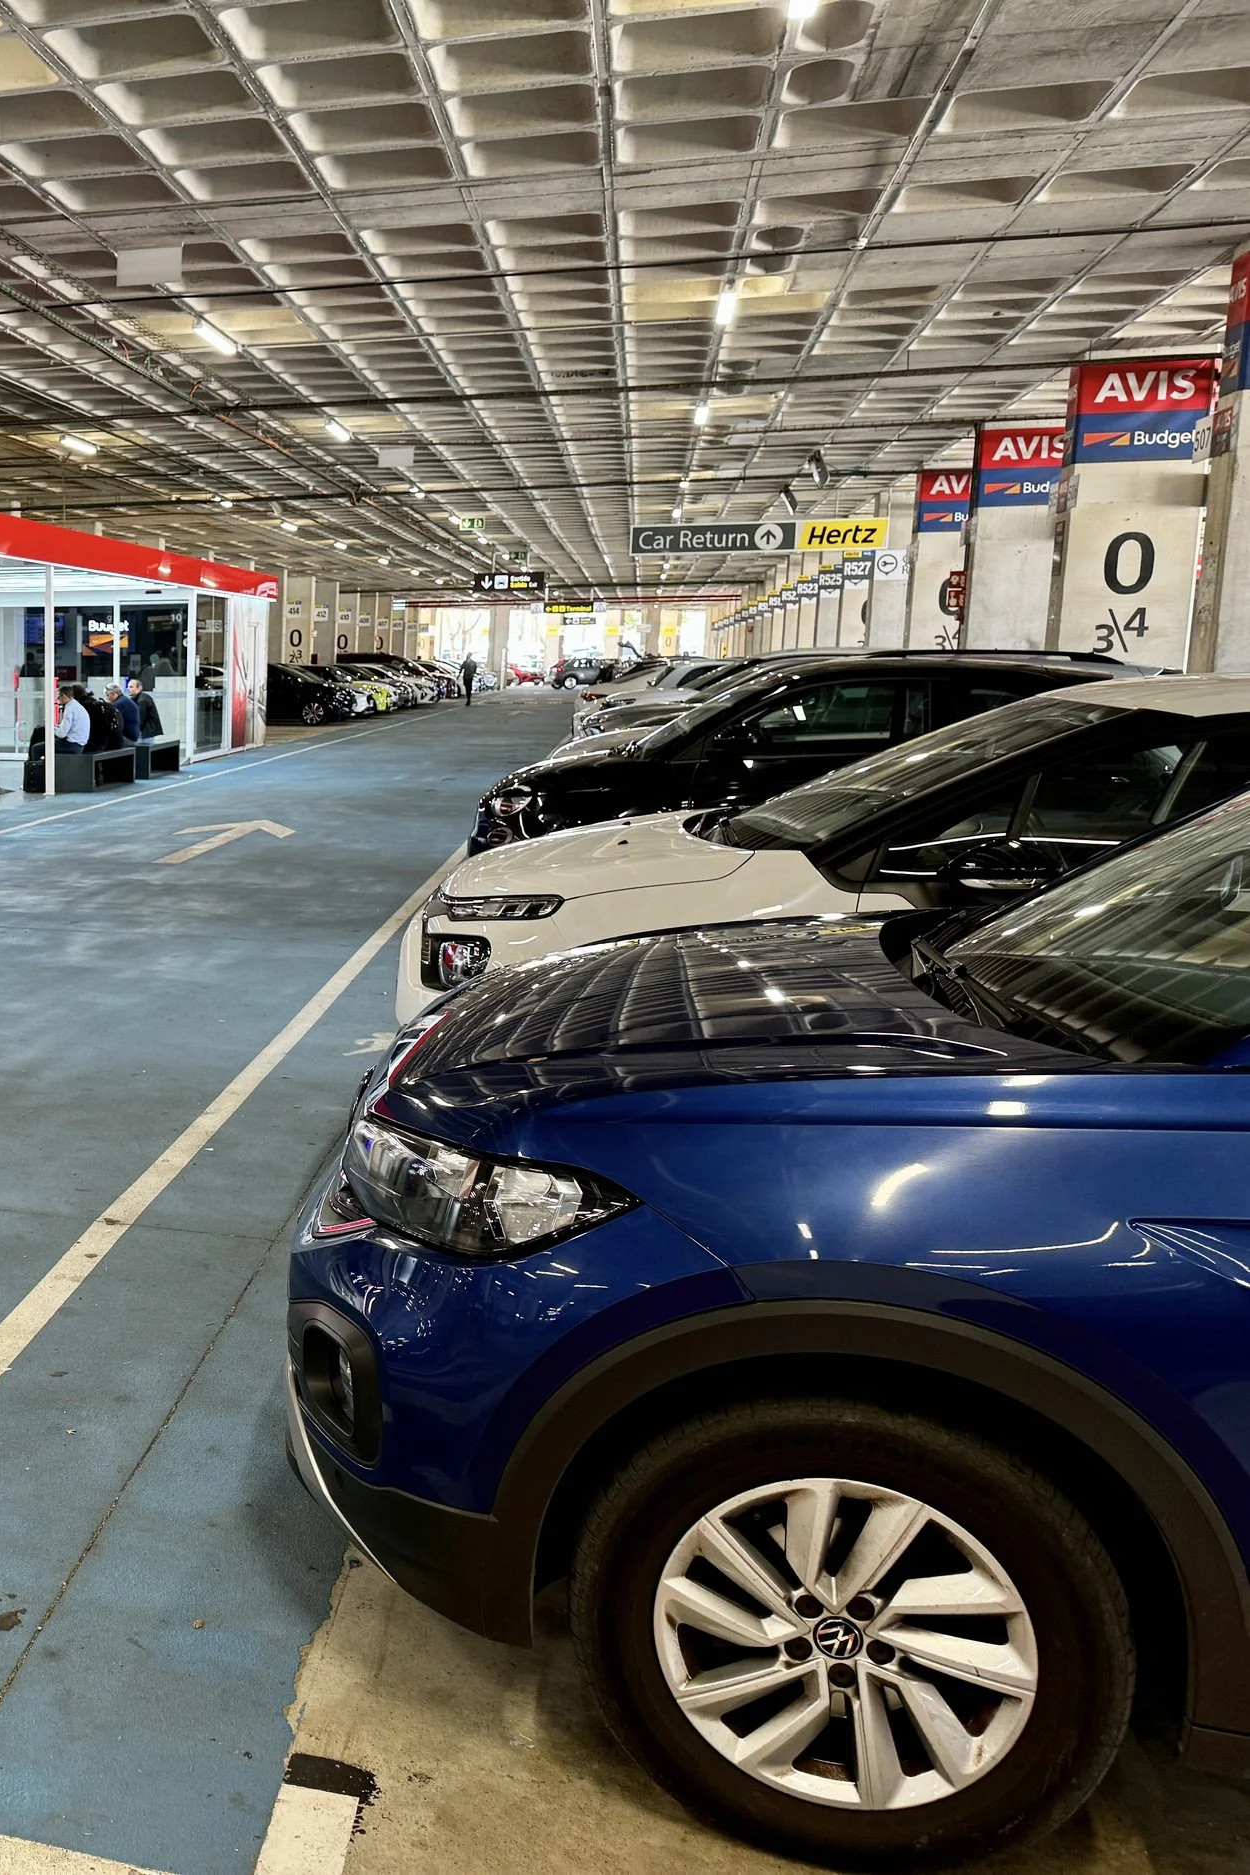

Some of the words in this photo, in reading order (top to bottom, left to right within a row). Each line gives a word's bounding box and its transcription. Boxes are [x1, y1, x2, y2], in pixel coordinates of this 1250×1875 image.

[1094, 369, 1197, 403] AVIS
[992, 435, 1065, 461] AVIS
[1194, 427, 1211, 452] 507
[929, 474, 971, 495] AV
[1023, 481, 1050, 494] Bud
[639, 531, 674, 549] Car
[680, 530, 749, 548] Return
[807, 525, 877, 544] Hertz
[844, 561, 872, 576] R527
[1104, 531, 1155, 595] 0
[819, 573, 843, 586] R525
[781, 591, 799, 601] R52
[797, 583, 818, 595] R523
[171, 613, 182, 622] 10
[288, 607, 299, 615] 414
[290, 629, 302, 647] 0
[337, 634, 348, 650] 0
